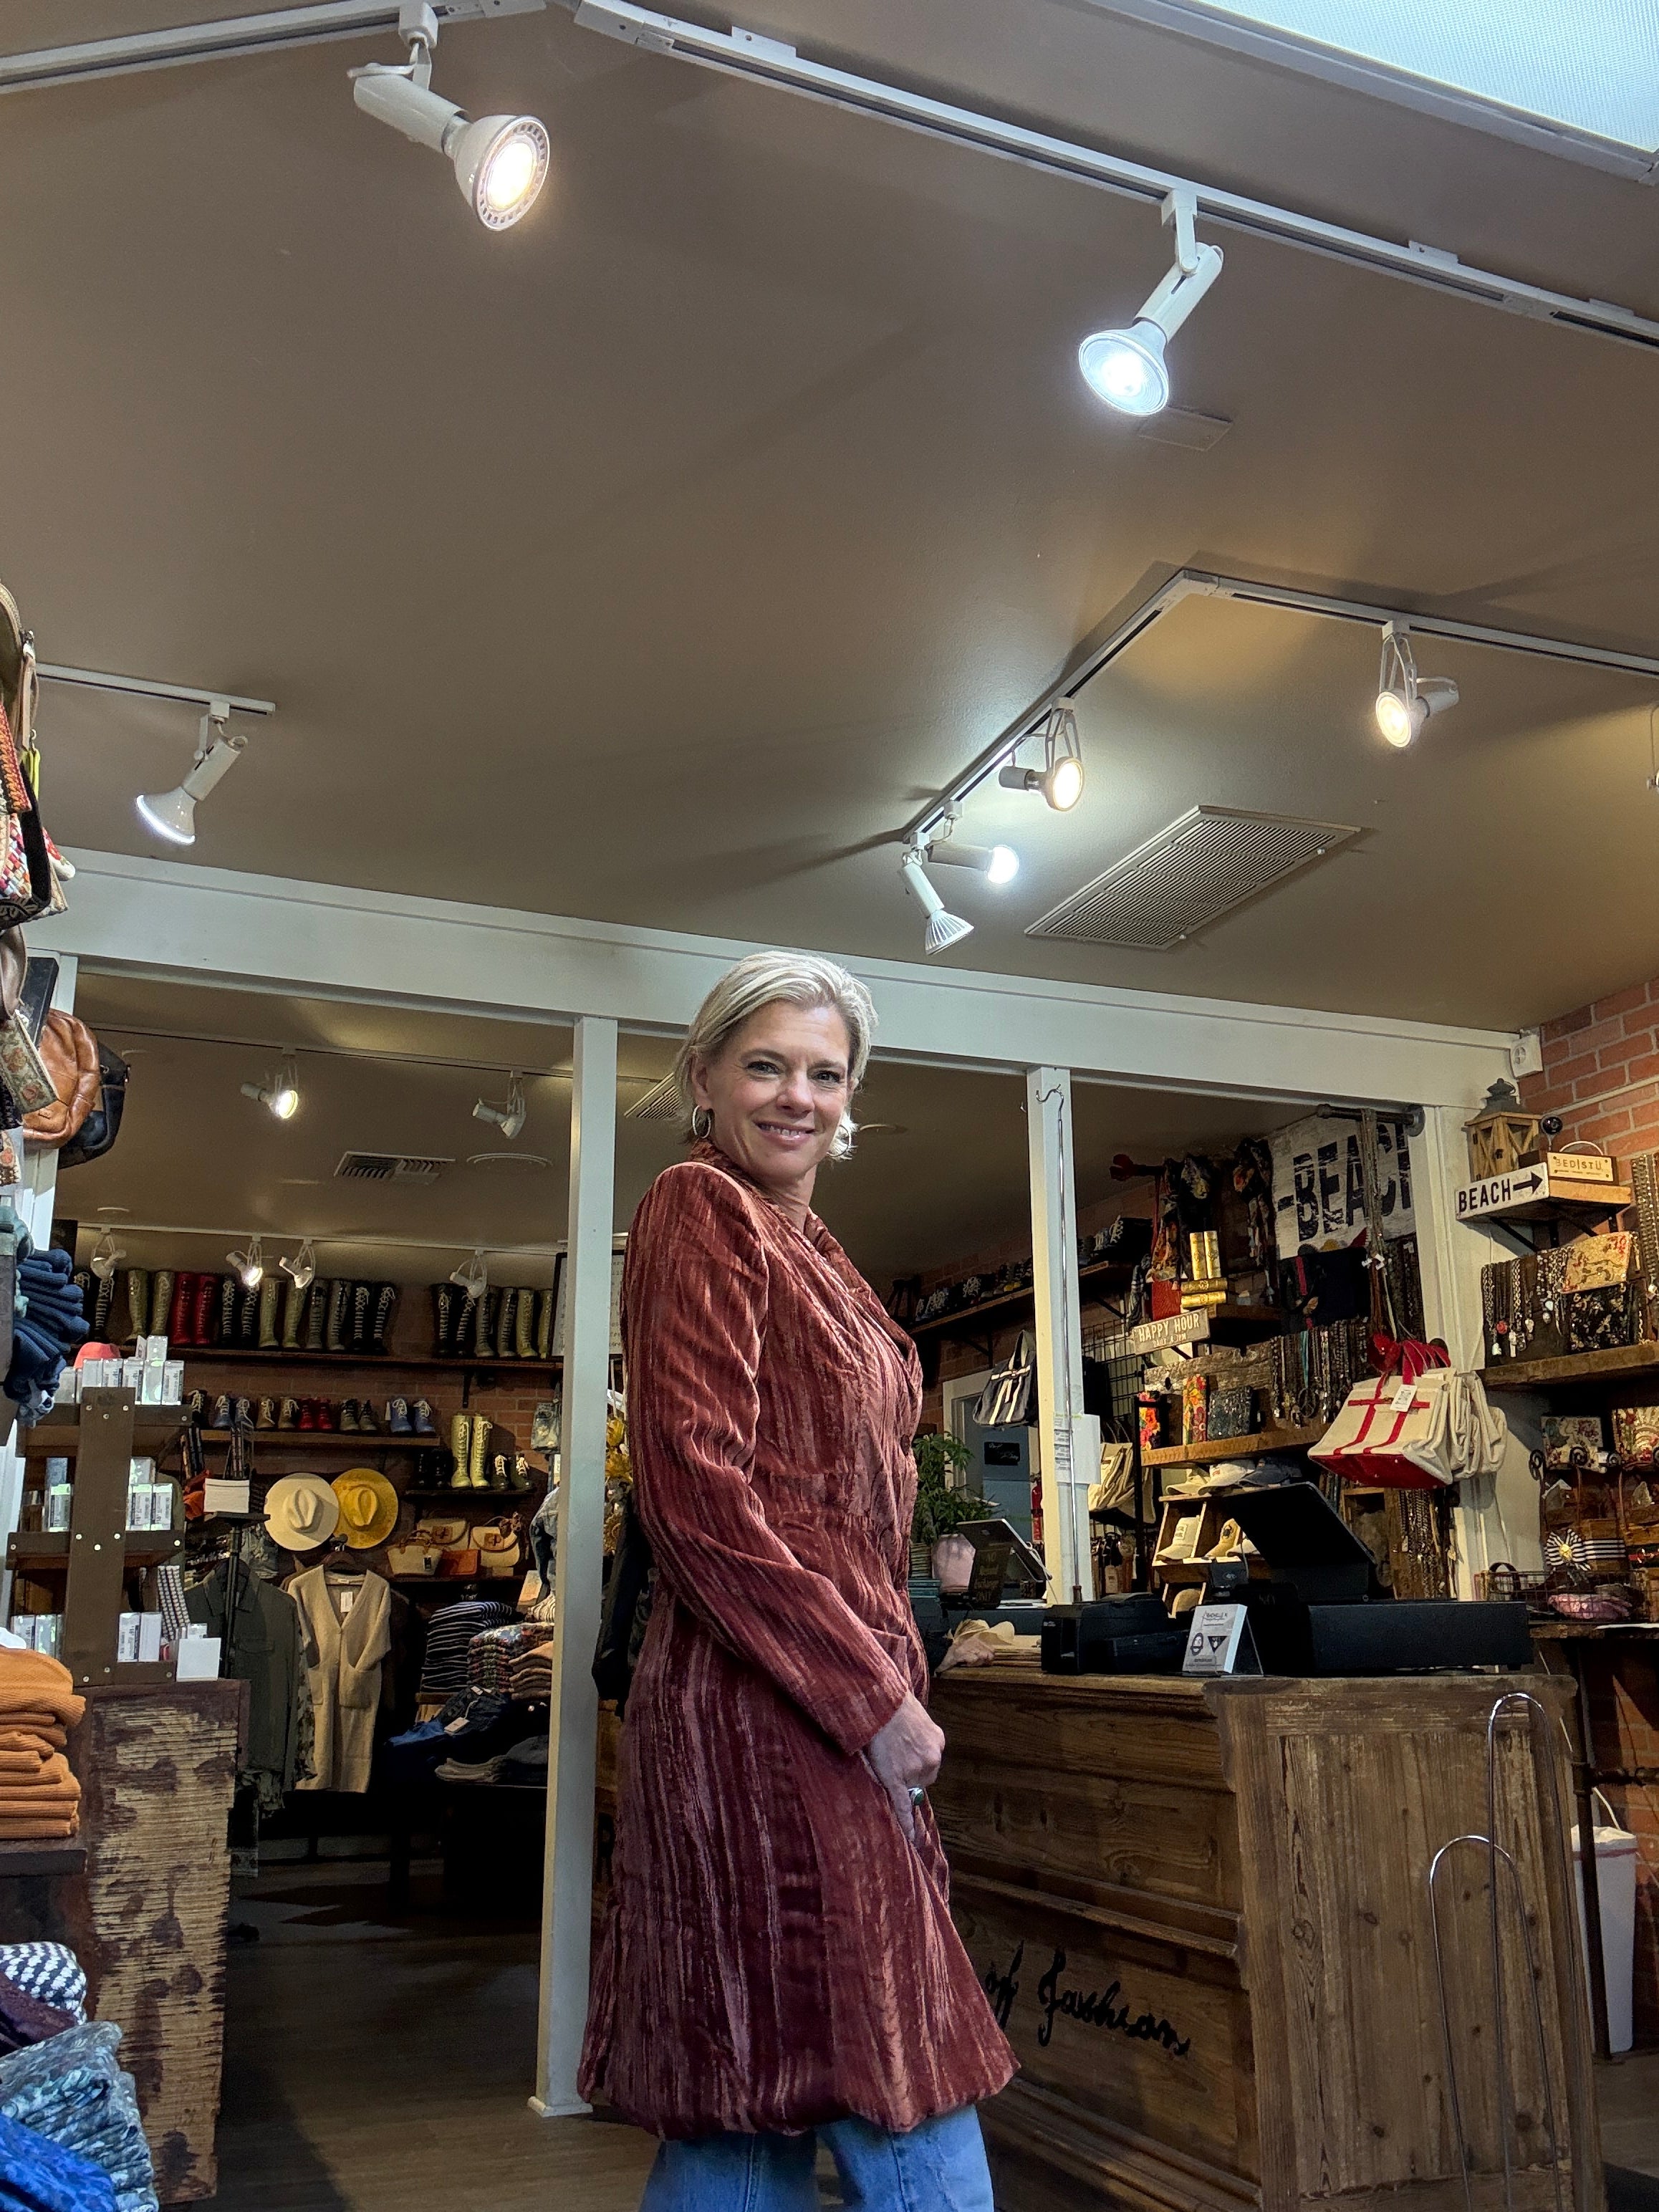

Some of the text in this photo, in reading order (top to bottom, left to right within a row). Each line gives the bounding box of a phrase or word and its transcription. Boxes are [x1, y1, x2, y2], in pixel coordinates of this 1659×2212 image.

[1458, 1178, 1511, 1213] BEACH
[1138, 1313, 1200, 1342] HAPPY HOUR
